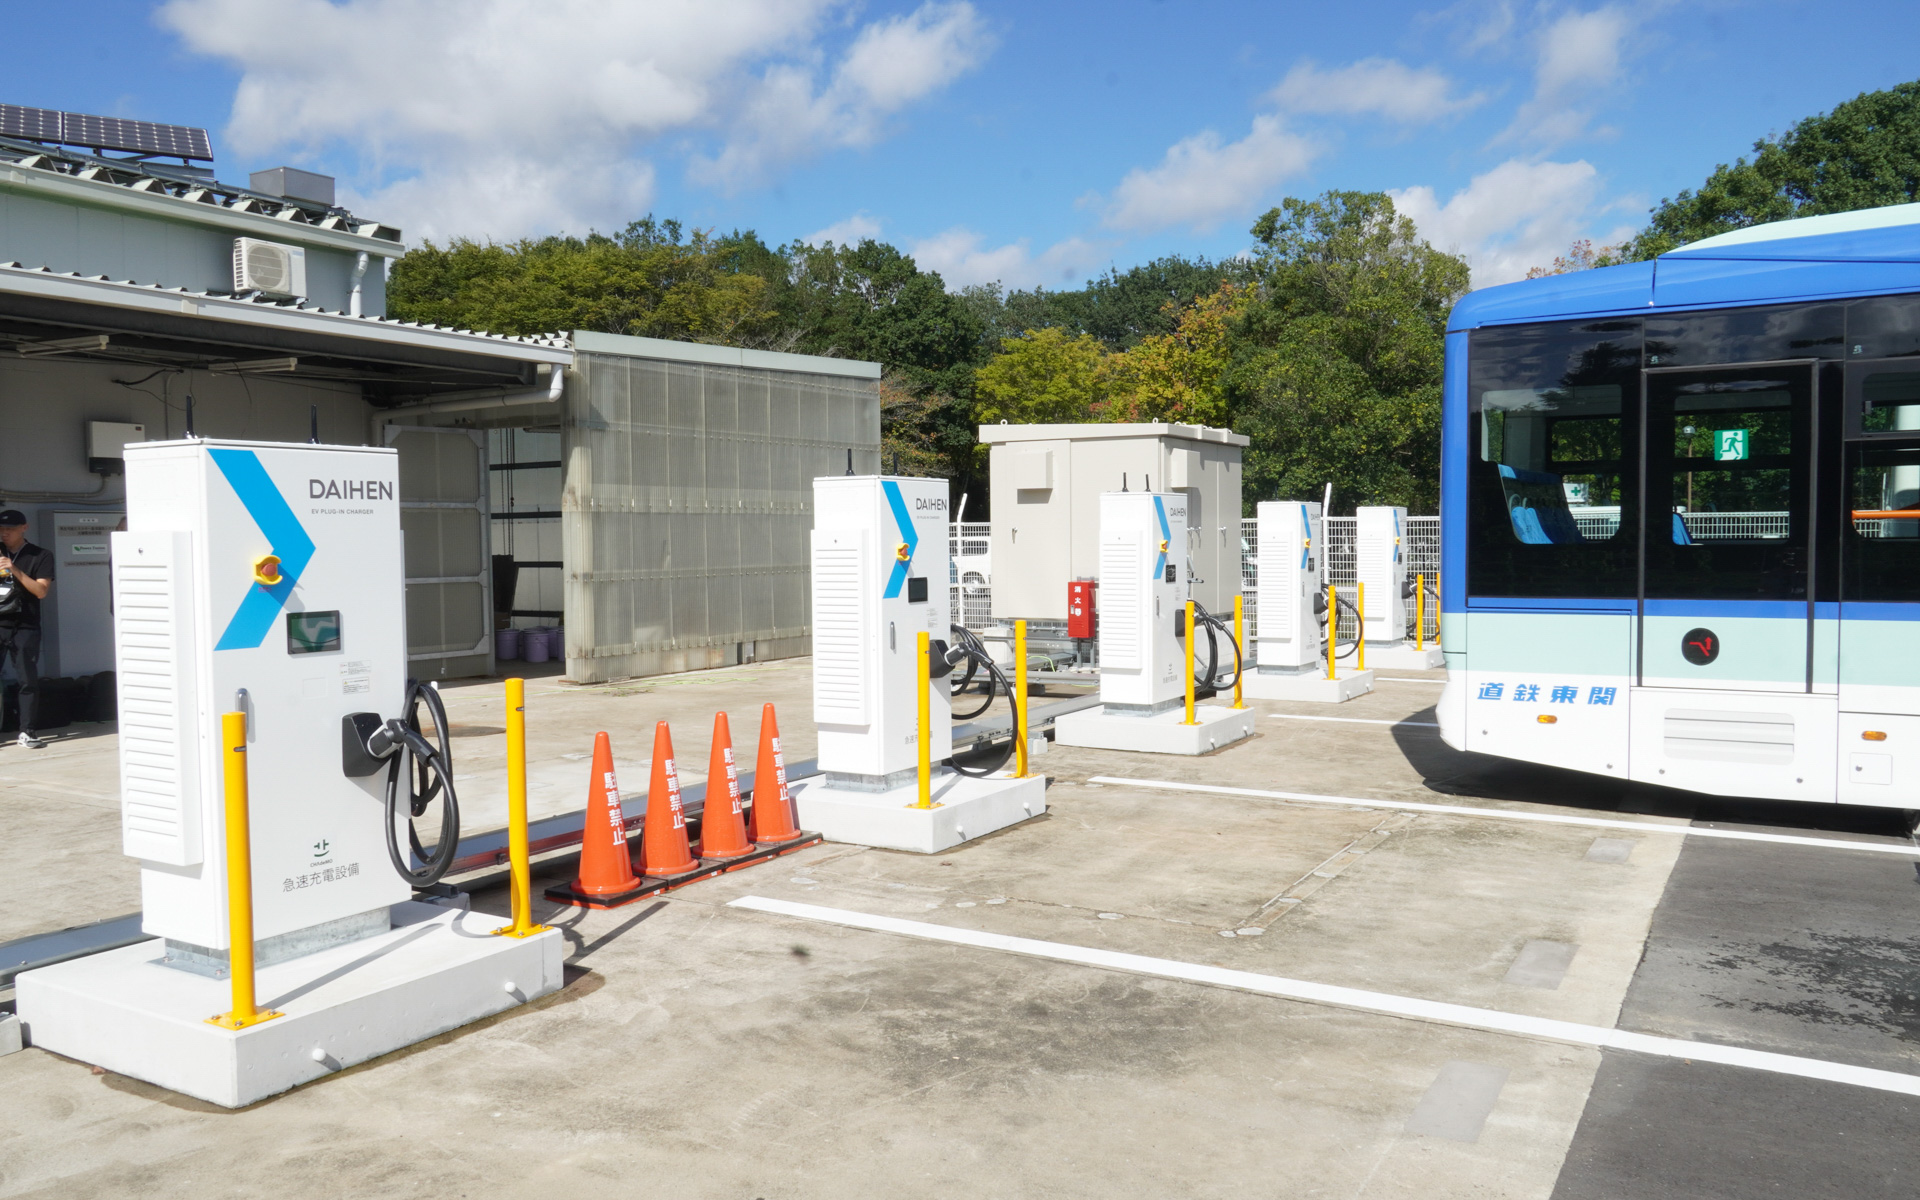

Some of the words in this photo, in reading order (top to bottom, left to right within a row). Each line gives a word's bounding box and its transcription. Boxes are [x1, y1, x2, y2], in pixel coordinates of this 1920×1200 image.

[309, 479, 393, 500] DAIHEN
[916, 498, 947, 511] DAIHEN
[665, 758, 684, 830] 駐車禁止
[724, 747, 742, 815] 駐車禁止
[604, 771, 626, 846] 駐車禁止
[282, 862, 360, 892] 急速充電設備
